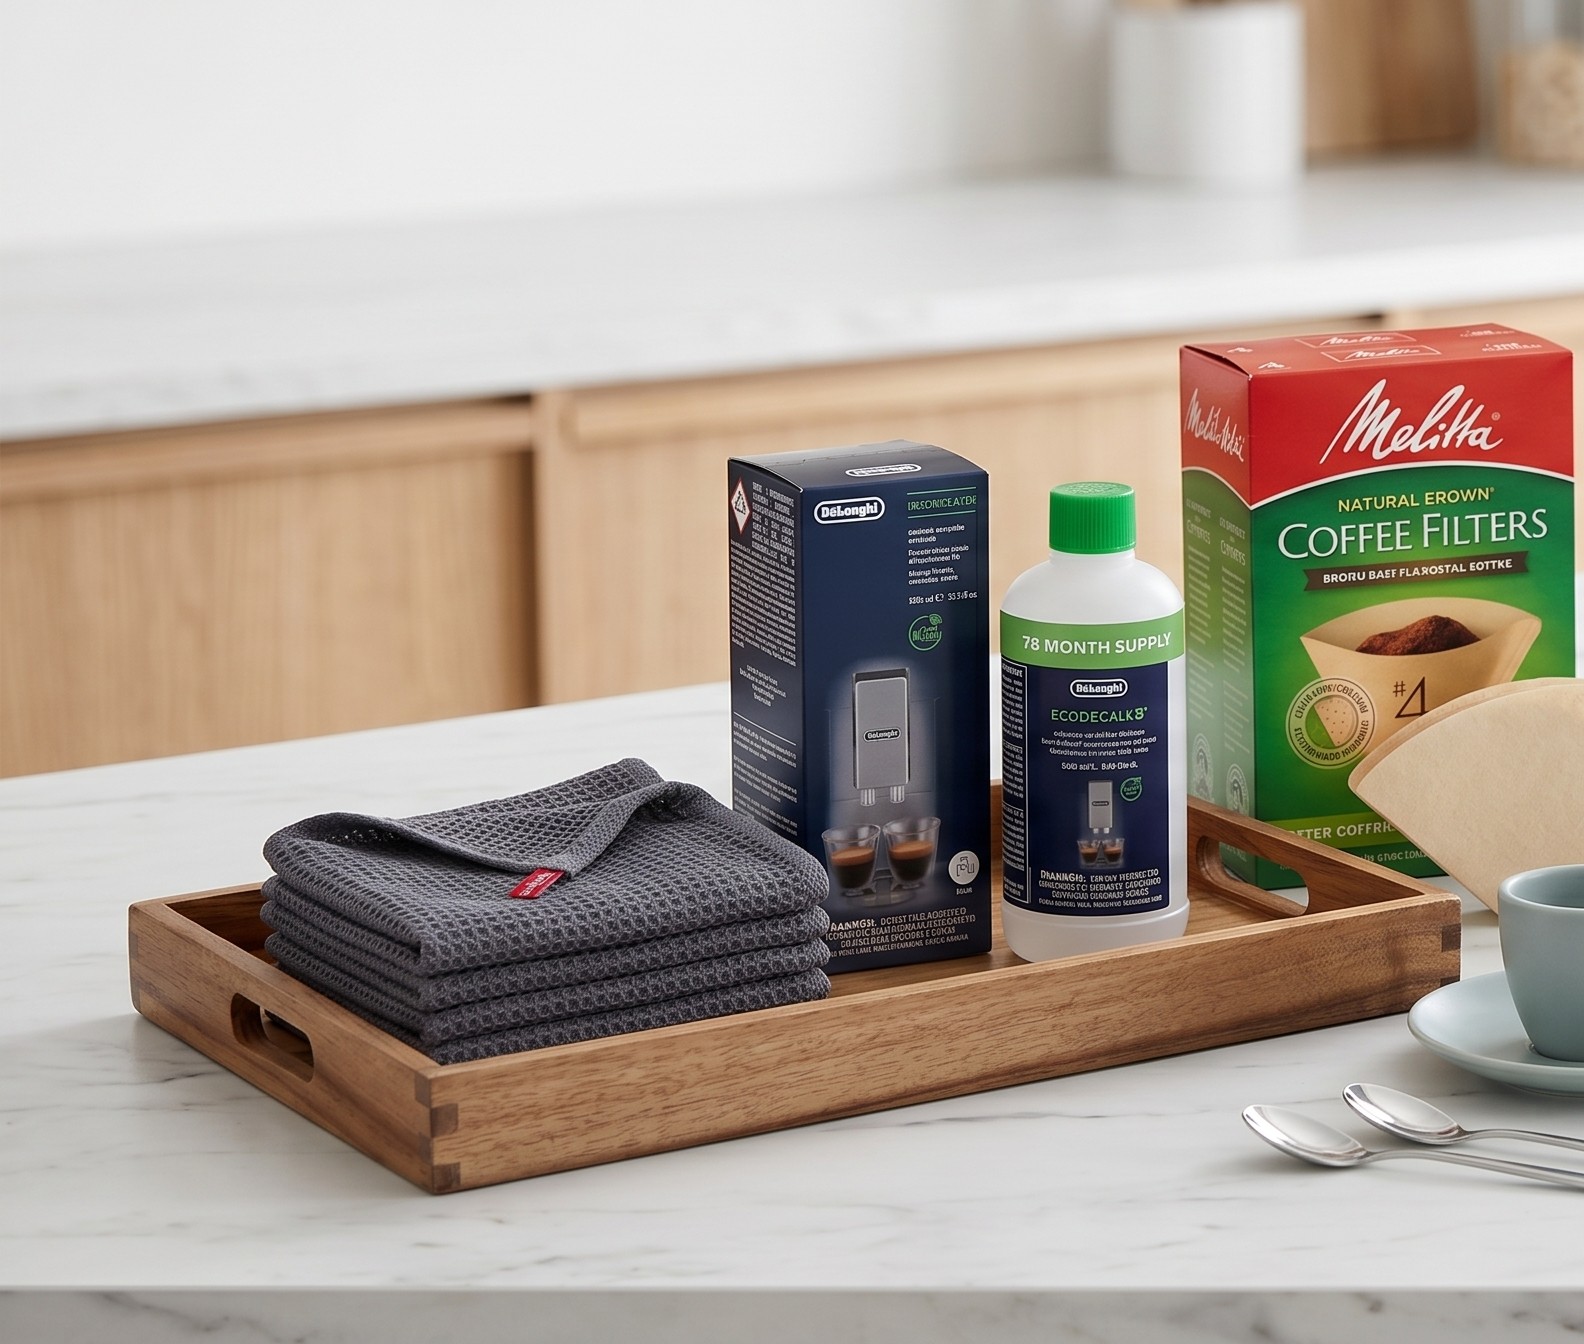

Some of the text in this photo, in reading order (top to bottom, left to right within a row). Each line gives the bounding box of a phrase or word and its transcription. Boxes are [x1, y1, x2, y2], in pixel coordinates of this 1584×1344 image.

[1338, 494, 1420, 513] NATURAL
[1277, 520, 1413, 559] COFFEE
[1422, 508, 1548, 547] FILTERS
[1022, 632, 1172, 654] 78 MONTH SUPPLY
